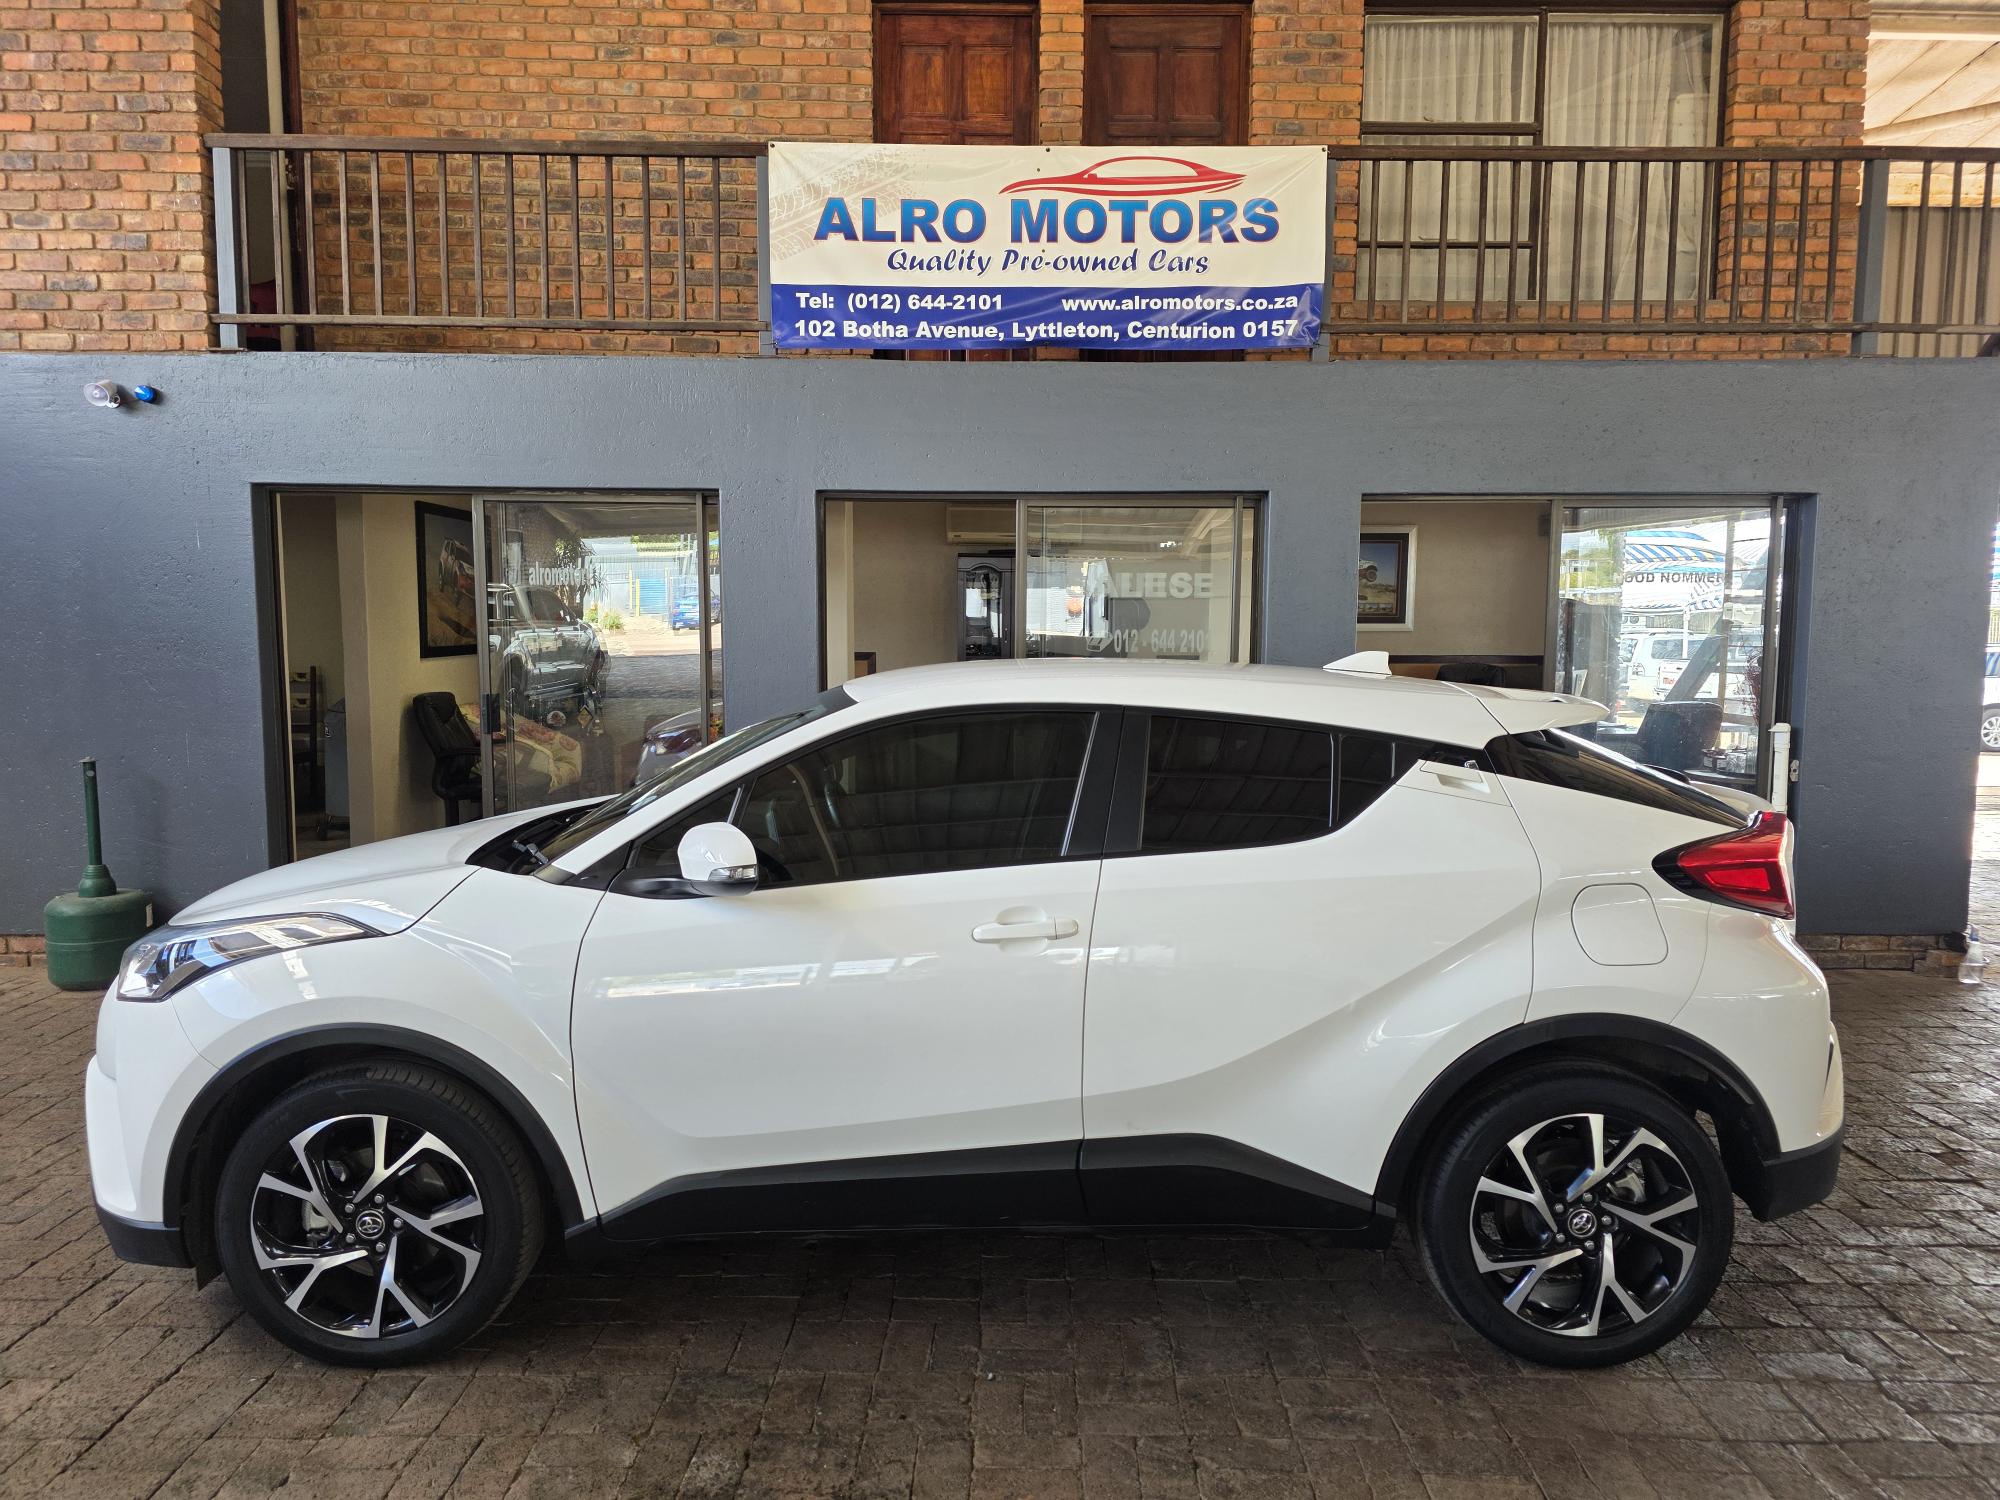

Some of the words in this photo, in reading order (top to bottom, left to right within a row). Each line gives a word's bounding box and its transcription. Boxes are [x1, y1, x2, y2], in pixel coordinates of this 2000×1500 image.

[813, 197, 987, 244] ALRO
[1010, 198, 1280, 244] MOTORS
[887, 248, 992, 277] Quality
[1001, 249, 1138, 272] Pre-owned
[1148, 249, 1209, 274] Cars
[796, 292, 834, 309] Tel:
[847, 293, 901, 313] (012)
[907, 294, 1002, 310] 644-2101
[1061, 293, 1299, 312] www.alromotors.co.za
[794, 320, 836, 337] 102
[843, 321, 908, 338] Botha
[915, 321, 1005, 342] Avenue,
[1012, 322, 1120, 342] Lyttleton,
[1127, 321, 1236, 339] Centurion
[1242, 319, 1299, 337] 0157
[1113, 629, 1139, 653] 012
[1151, 629, 1176, 653] 644
